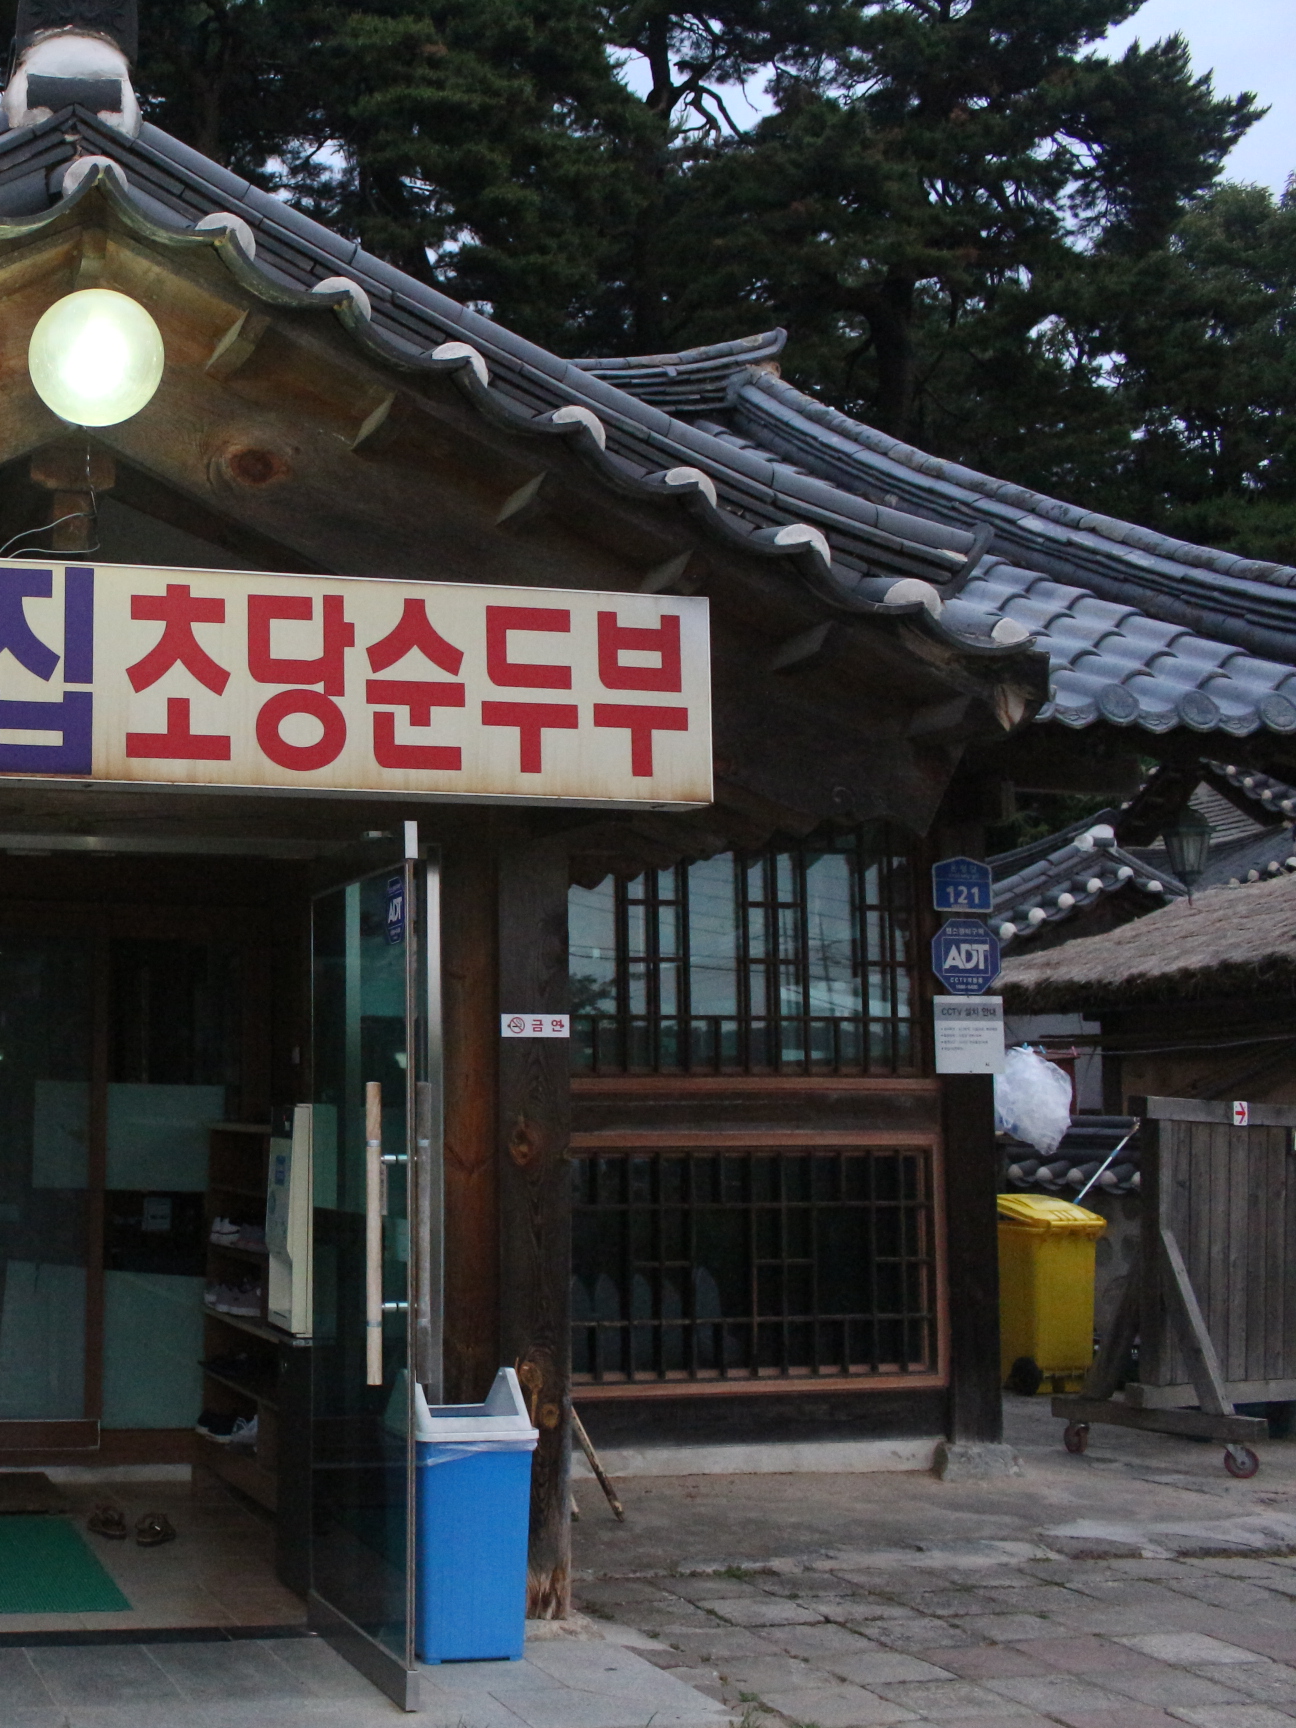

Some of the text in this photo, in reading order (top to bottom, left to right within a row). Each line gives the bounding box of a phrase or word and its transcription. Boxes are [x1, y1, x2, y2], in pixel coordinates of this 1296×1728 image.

[125, 583, 689, 778] 초당순두부
[946, 886, 979, 904] 121
[387, 896, 403, 924] ADT
[943, 943, 989, 970] ADT
[941, 1007, 962, 1016] CCTV
[981, 1007, 997, 1017] 안내
